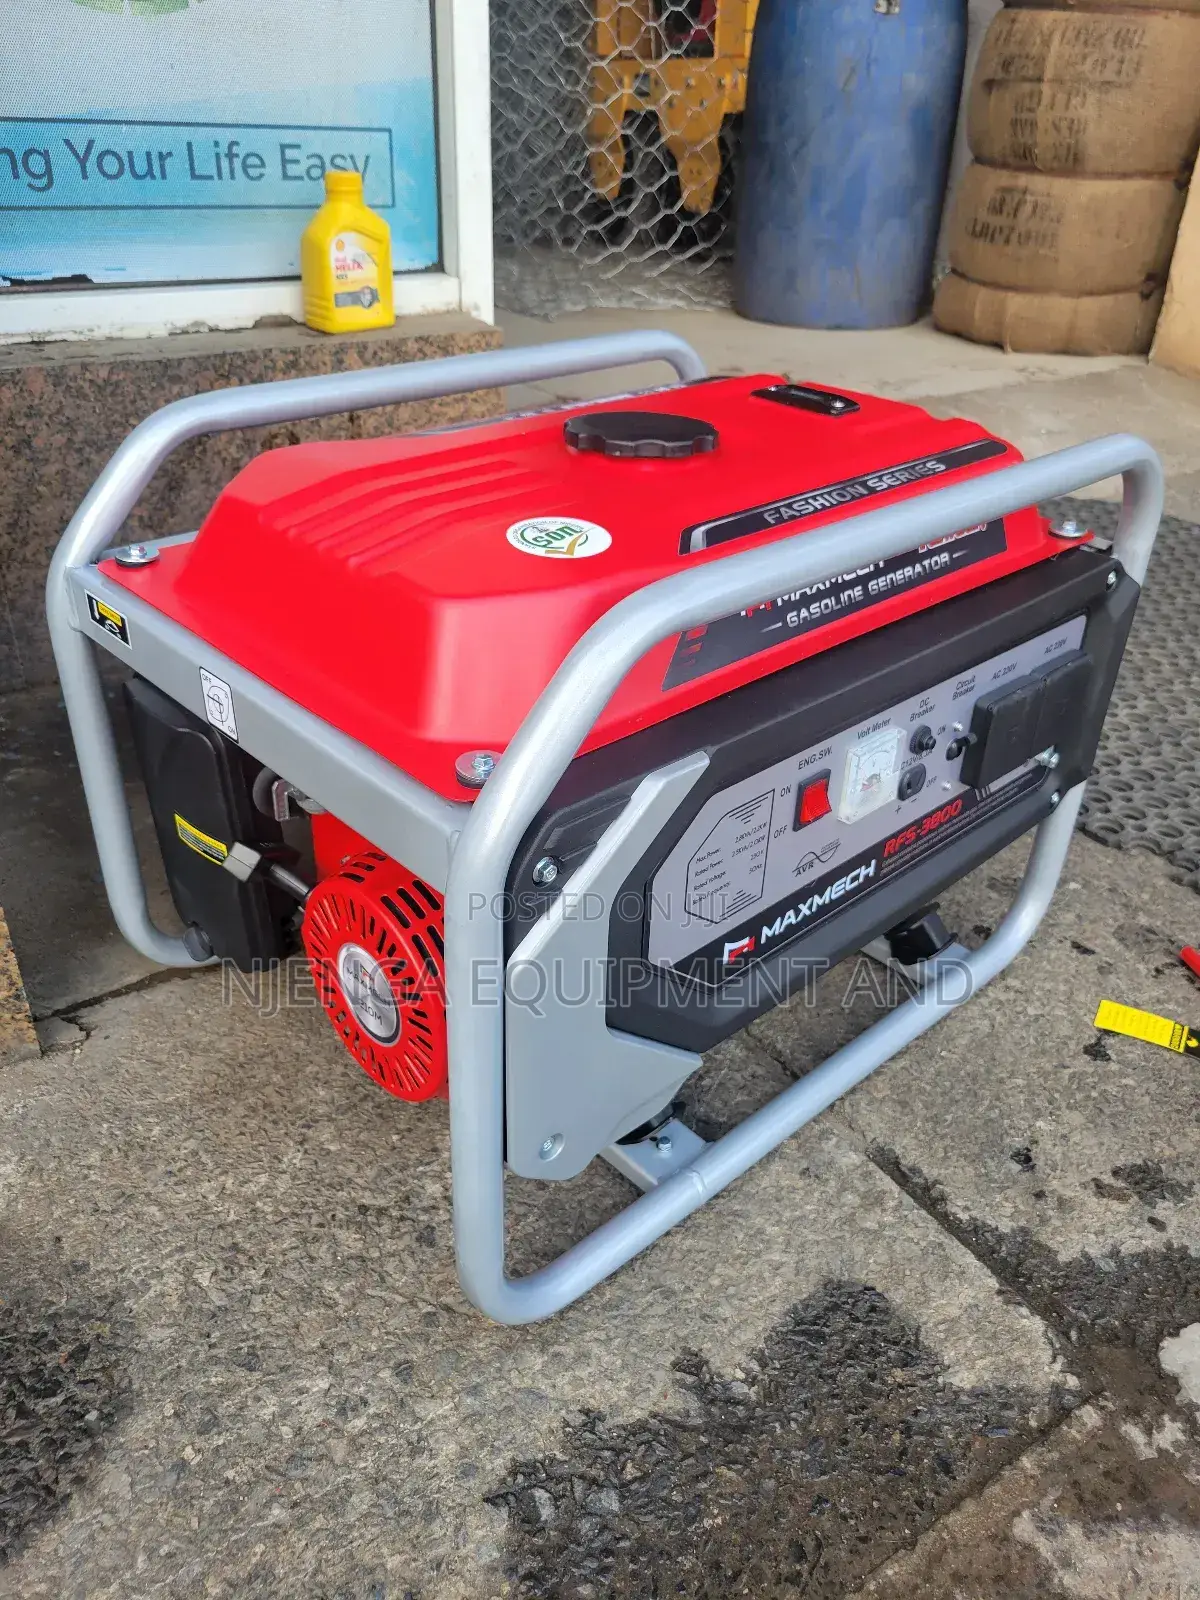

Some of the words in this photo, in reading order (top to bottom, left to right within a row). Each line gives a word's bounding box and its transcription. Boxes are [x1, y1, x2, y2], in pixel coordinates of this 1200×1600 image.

[63, 139, 173, 182] Your
[187, 140, 267, 182] Life
[280, 144, 370, 187] Easy
[763, 483, 867, 525] FASHION
[866, 460, 947, 492] SERIES
[787, 585, 865, 627] GASOLINE
[868, 551, 950, 596] GENERATOR
[992, 670, 1002, 681] AC
[952, 683, 976, 701] Breaker
[910, 704, 936, 722] Breaker
[919, 697, 930, 709] DC
[857, 727, 872, 741] Volt
[871, 718, 892, 733] Meter
[798, 746, 833, 770] ENG.SW.
[780, 784, 792, 798] ON
[773, 825, 788, 839] OFF
[883, 799, 963, 858] RFS-3800
[795, 861, 814, 877] AVR
[760, 859, 877, 944] MAXMECH
